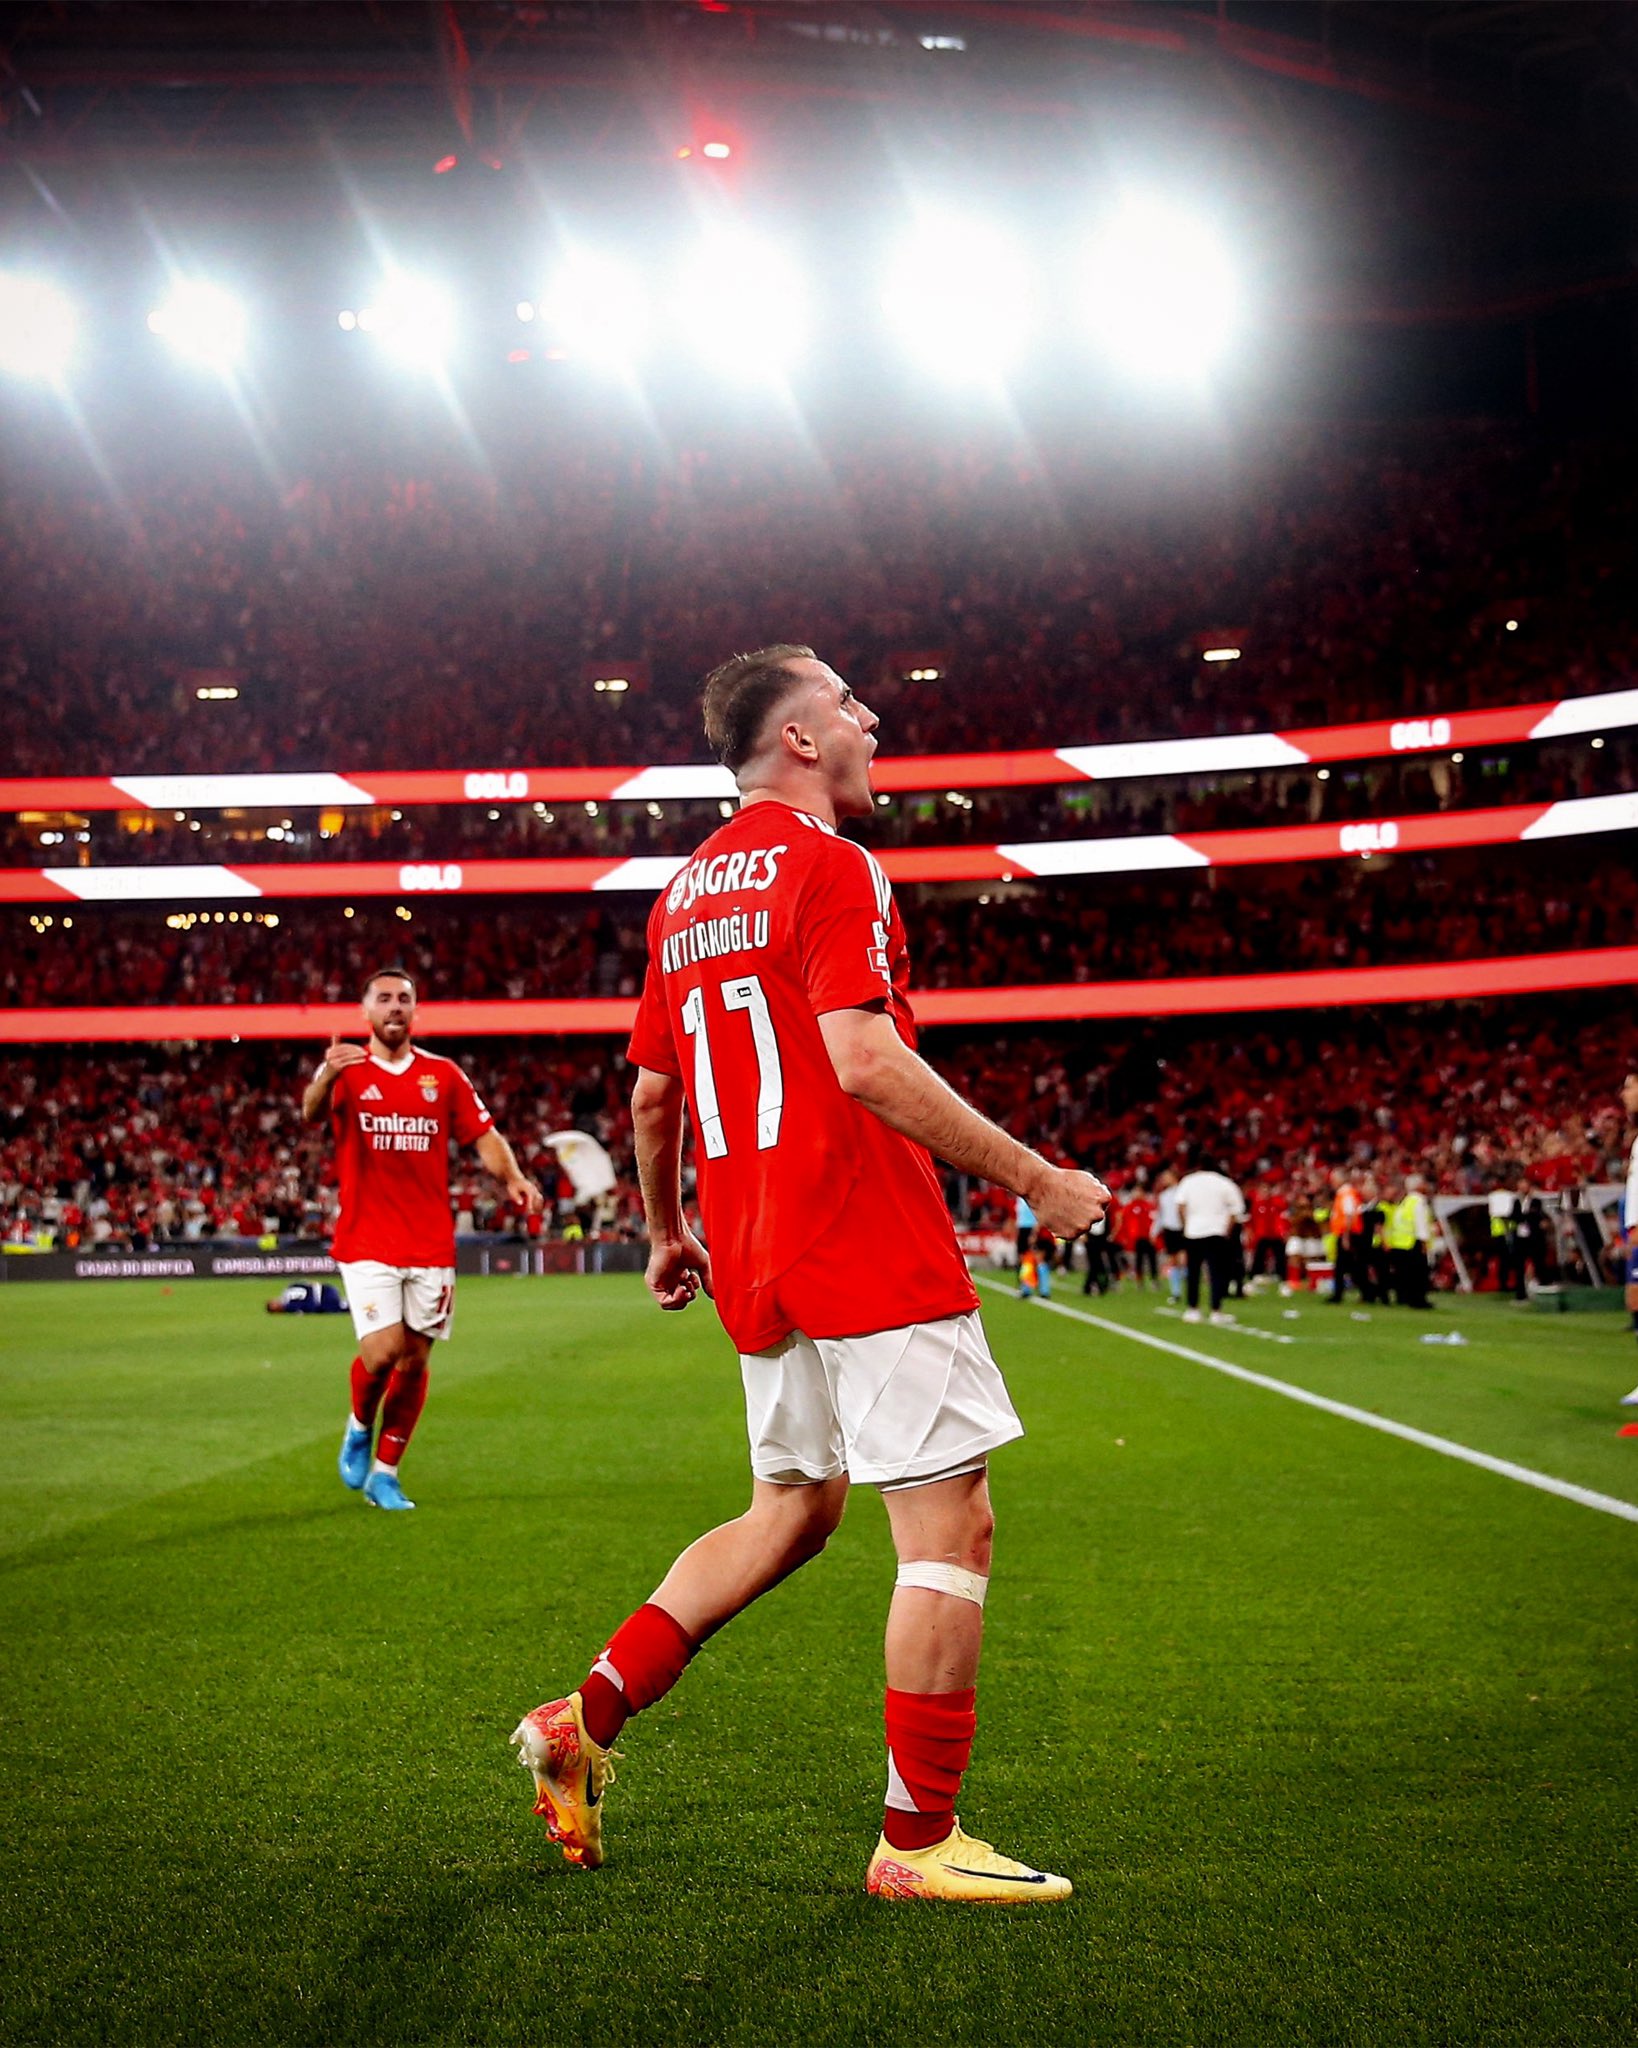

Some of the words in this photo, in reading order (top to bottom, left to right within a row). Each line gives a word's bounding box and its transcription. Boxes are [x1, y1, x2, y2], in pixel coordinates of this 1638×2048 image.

[682, 845, 789, 910] SAGRES
[681, 975, 783, 1159] 17
[358, 1112, 438, 1134] Emirates
[373, 1134, 392, 1150] FLY
[394, 1135, 429, 1151] BETTER
